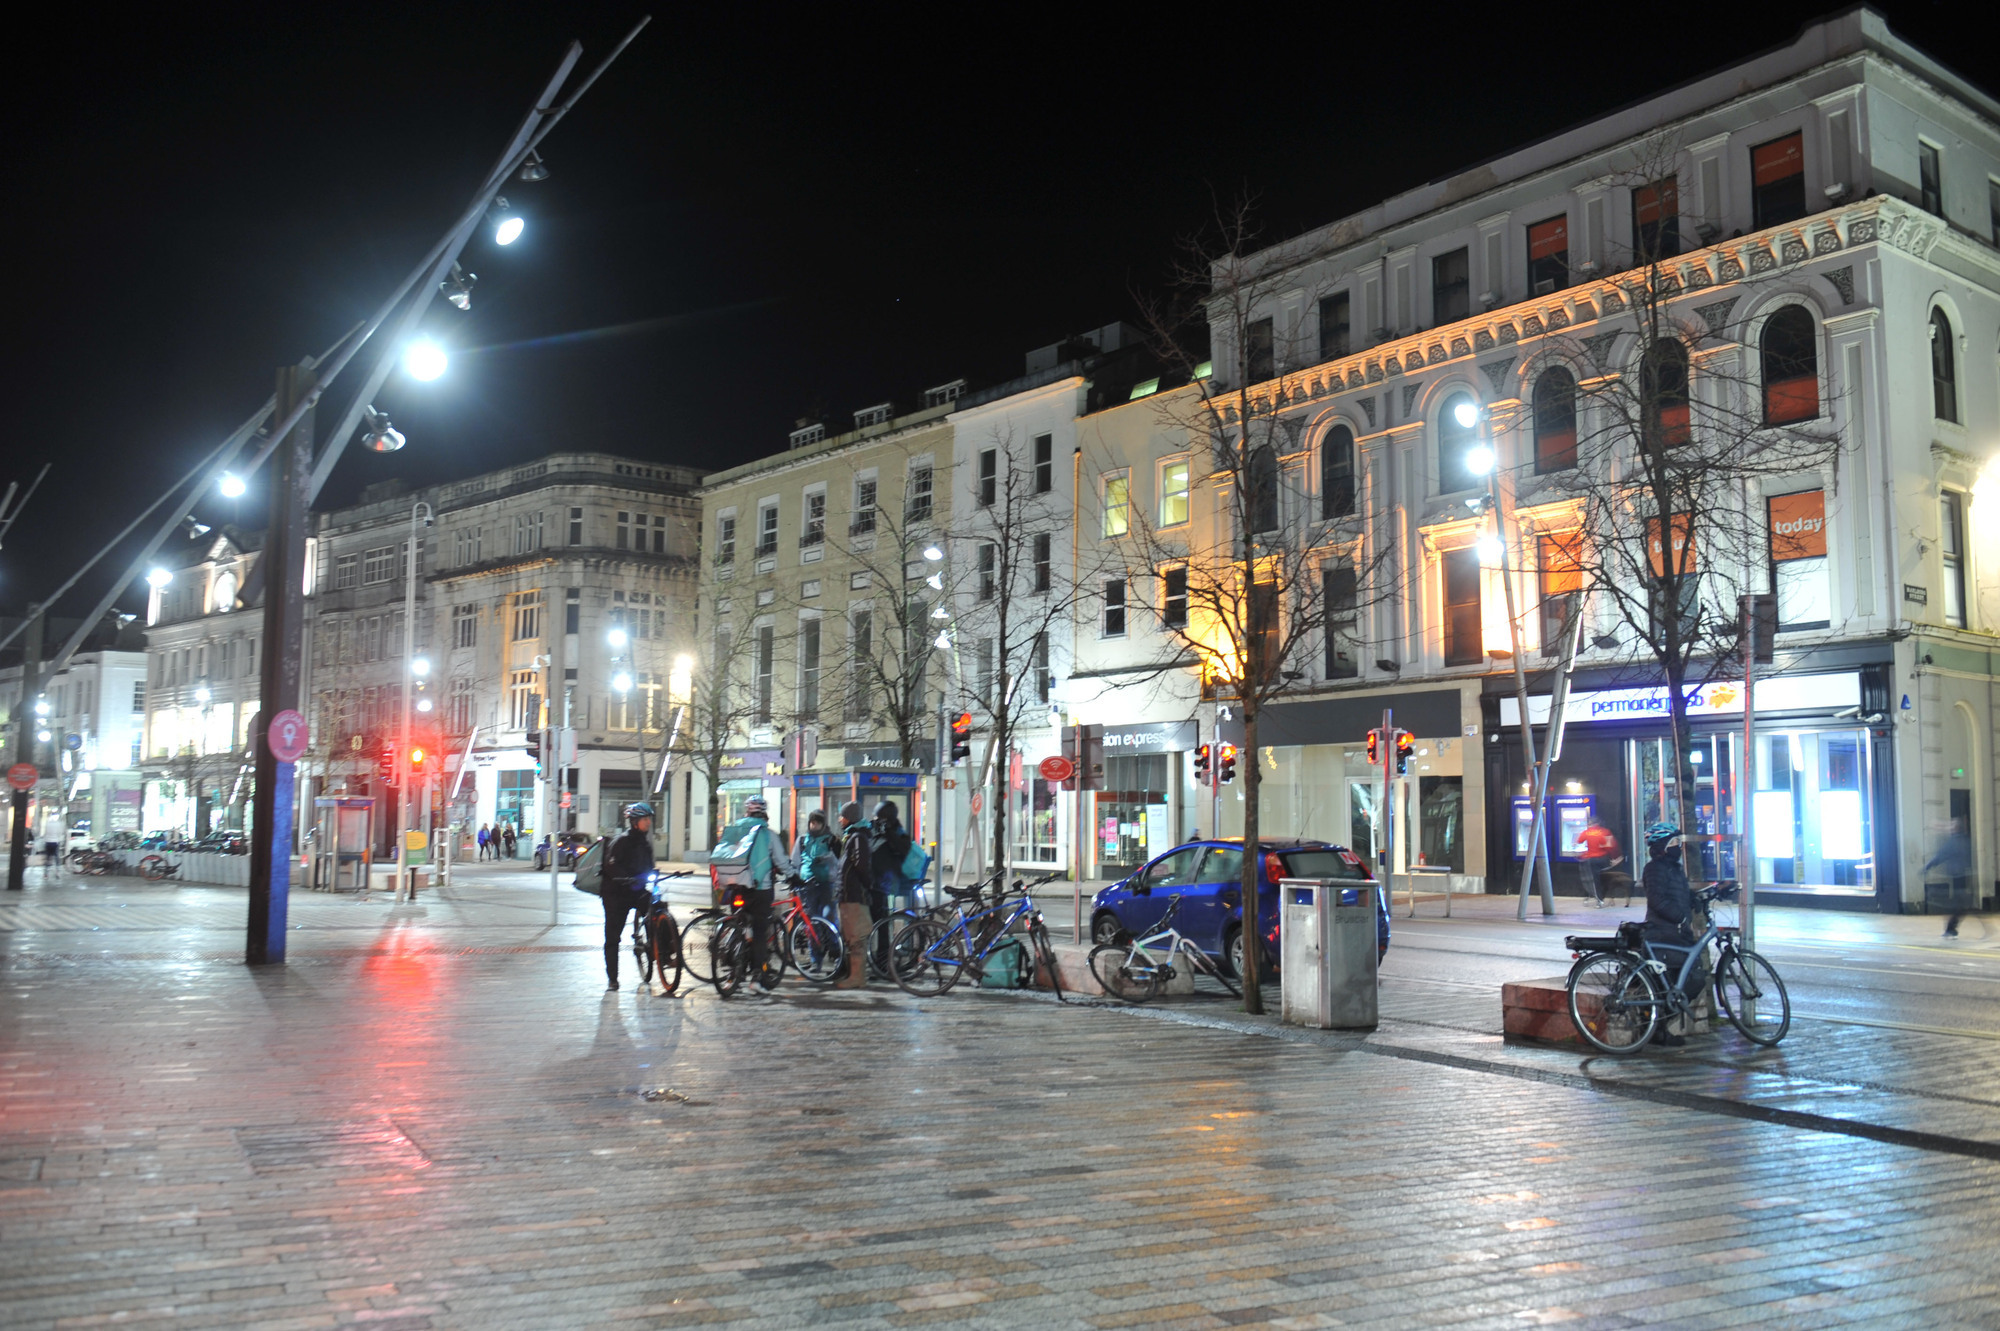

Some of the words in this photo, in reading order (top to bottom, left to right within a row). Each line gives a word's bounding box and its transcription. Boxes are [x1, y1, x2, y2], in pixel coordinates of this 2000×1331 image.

[1775, 516, 1823, 535] today
[1592, 697, 1670, 717] permanen
[1123, 731, 1167, 749] express
[880, 774, 907, 784] eircom
